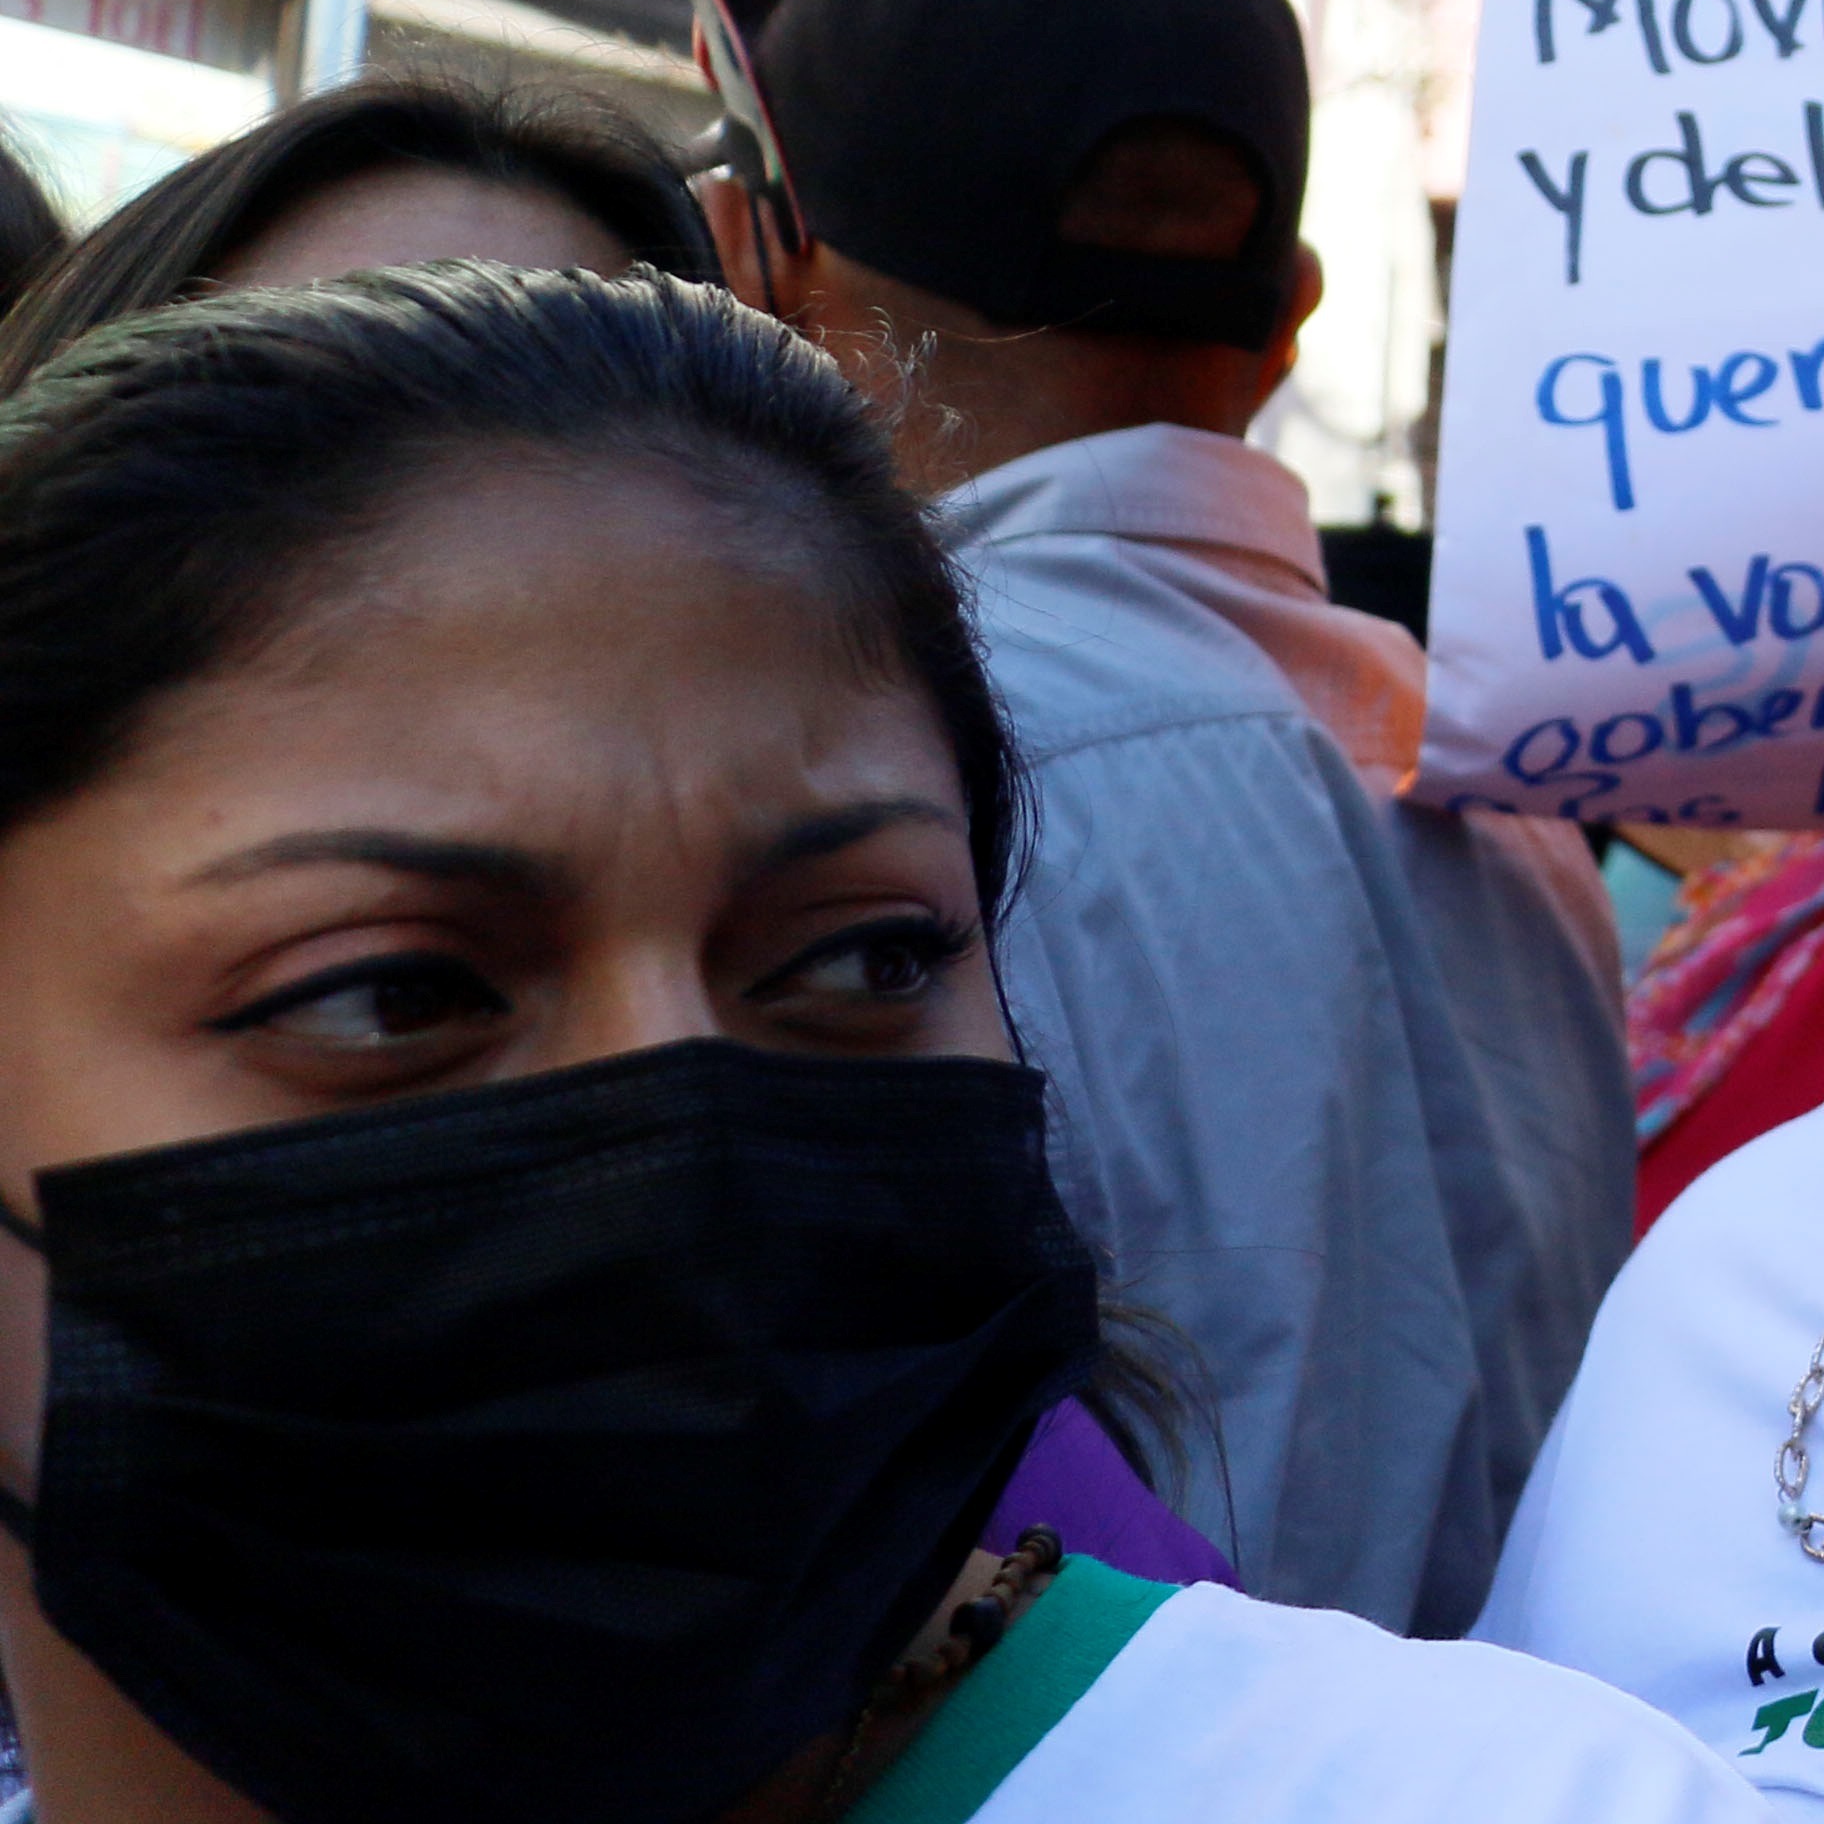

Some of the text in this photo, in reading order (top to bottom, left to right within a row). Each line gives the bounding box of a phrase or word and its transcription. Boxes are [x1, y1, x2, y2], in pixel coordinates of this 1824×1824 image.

[1518, 150, 1588, 285] y
[1525, 526, 1655, 664] la
[1747, 1626, 1785, 1686] A
